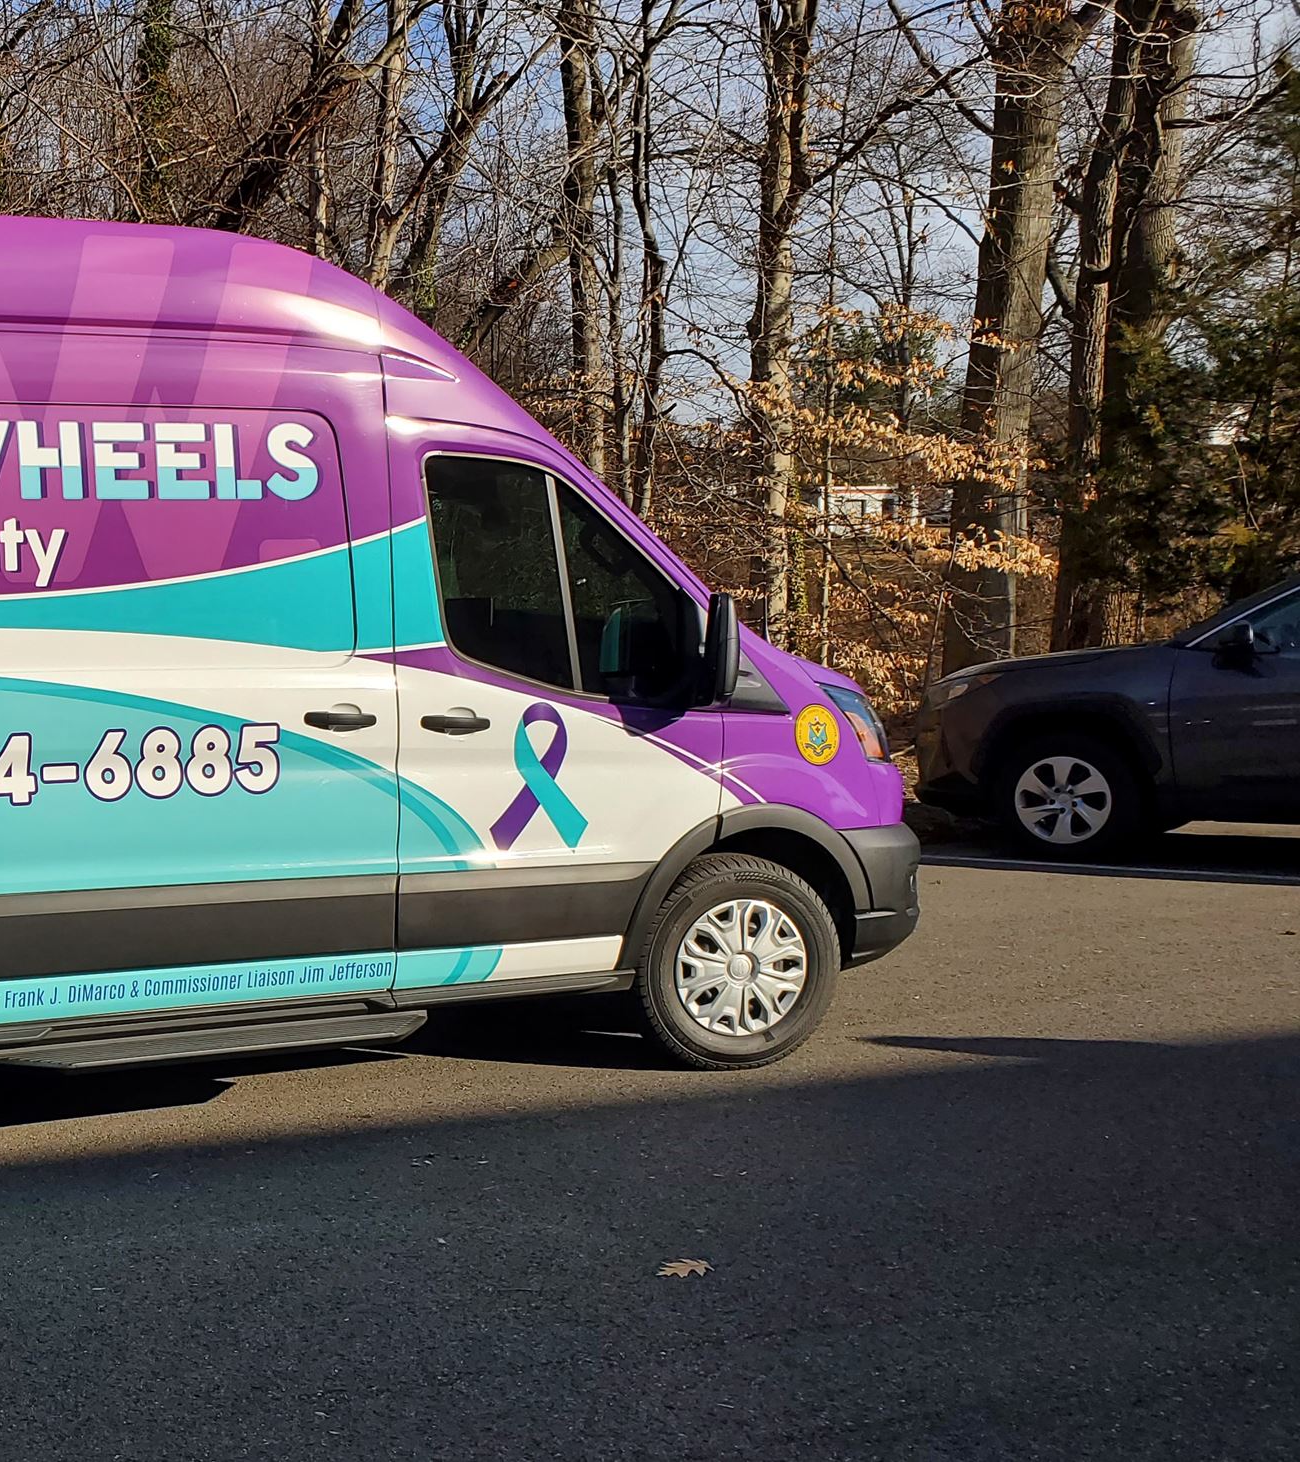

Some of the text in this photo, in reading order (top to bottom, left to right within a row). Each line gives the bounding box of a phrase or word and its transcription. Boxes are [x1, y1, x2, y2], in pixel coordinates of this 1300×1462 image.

[4, 987, 45, 1009] Frank
[49, 986, 62, 1005] J.
[68, 982, 125, 1003] DiMarco
[130, 980, 141, 998] &
[143, 972, 244, 997] Commissioner
[247, 968, 296, 989] Liaison
[299, 964, 325, 984] Jim
[328, 959, 393, 981] Jefferson
